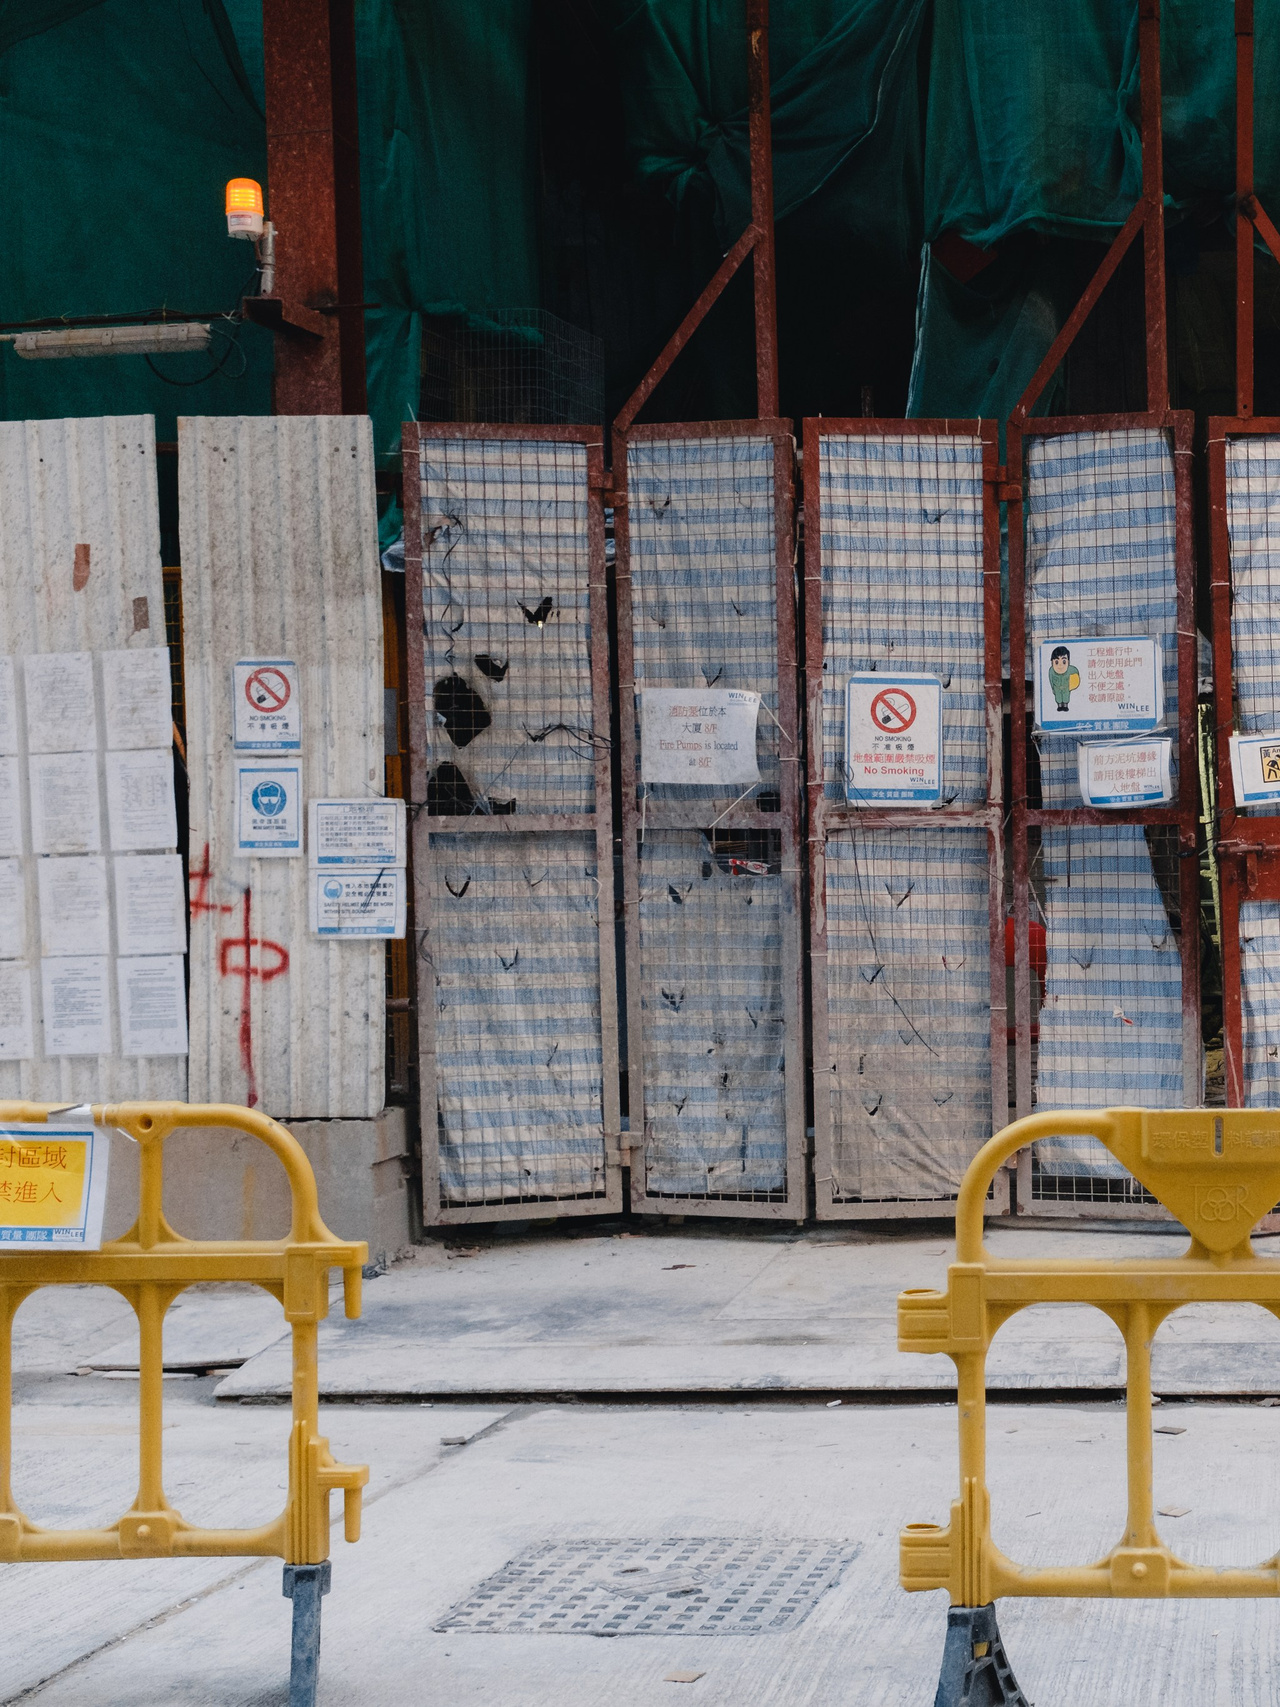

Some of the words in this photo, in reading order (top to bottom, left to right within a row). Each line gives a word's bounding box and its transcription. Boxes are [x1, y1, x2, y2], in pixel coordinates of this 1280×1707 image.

[704, 723, 718, 734] 8/F
[660, 740, 675, 750] Fire
[676, 740, 702, 751] Pumps
[705, 740, 712, 749] is
[714, 740, 739, 751] located
[864, 766, 878, 775] No
[880, 766, 924, 776] Smoking
